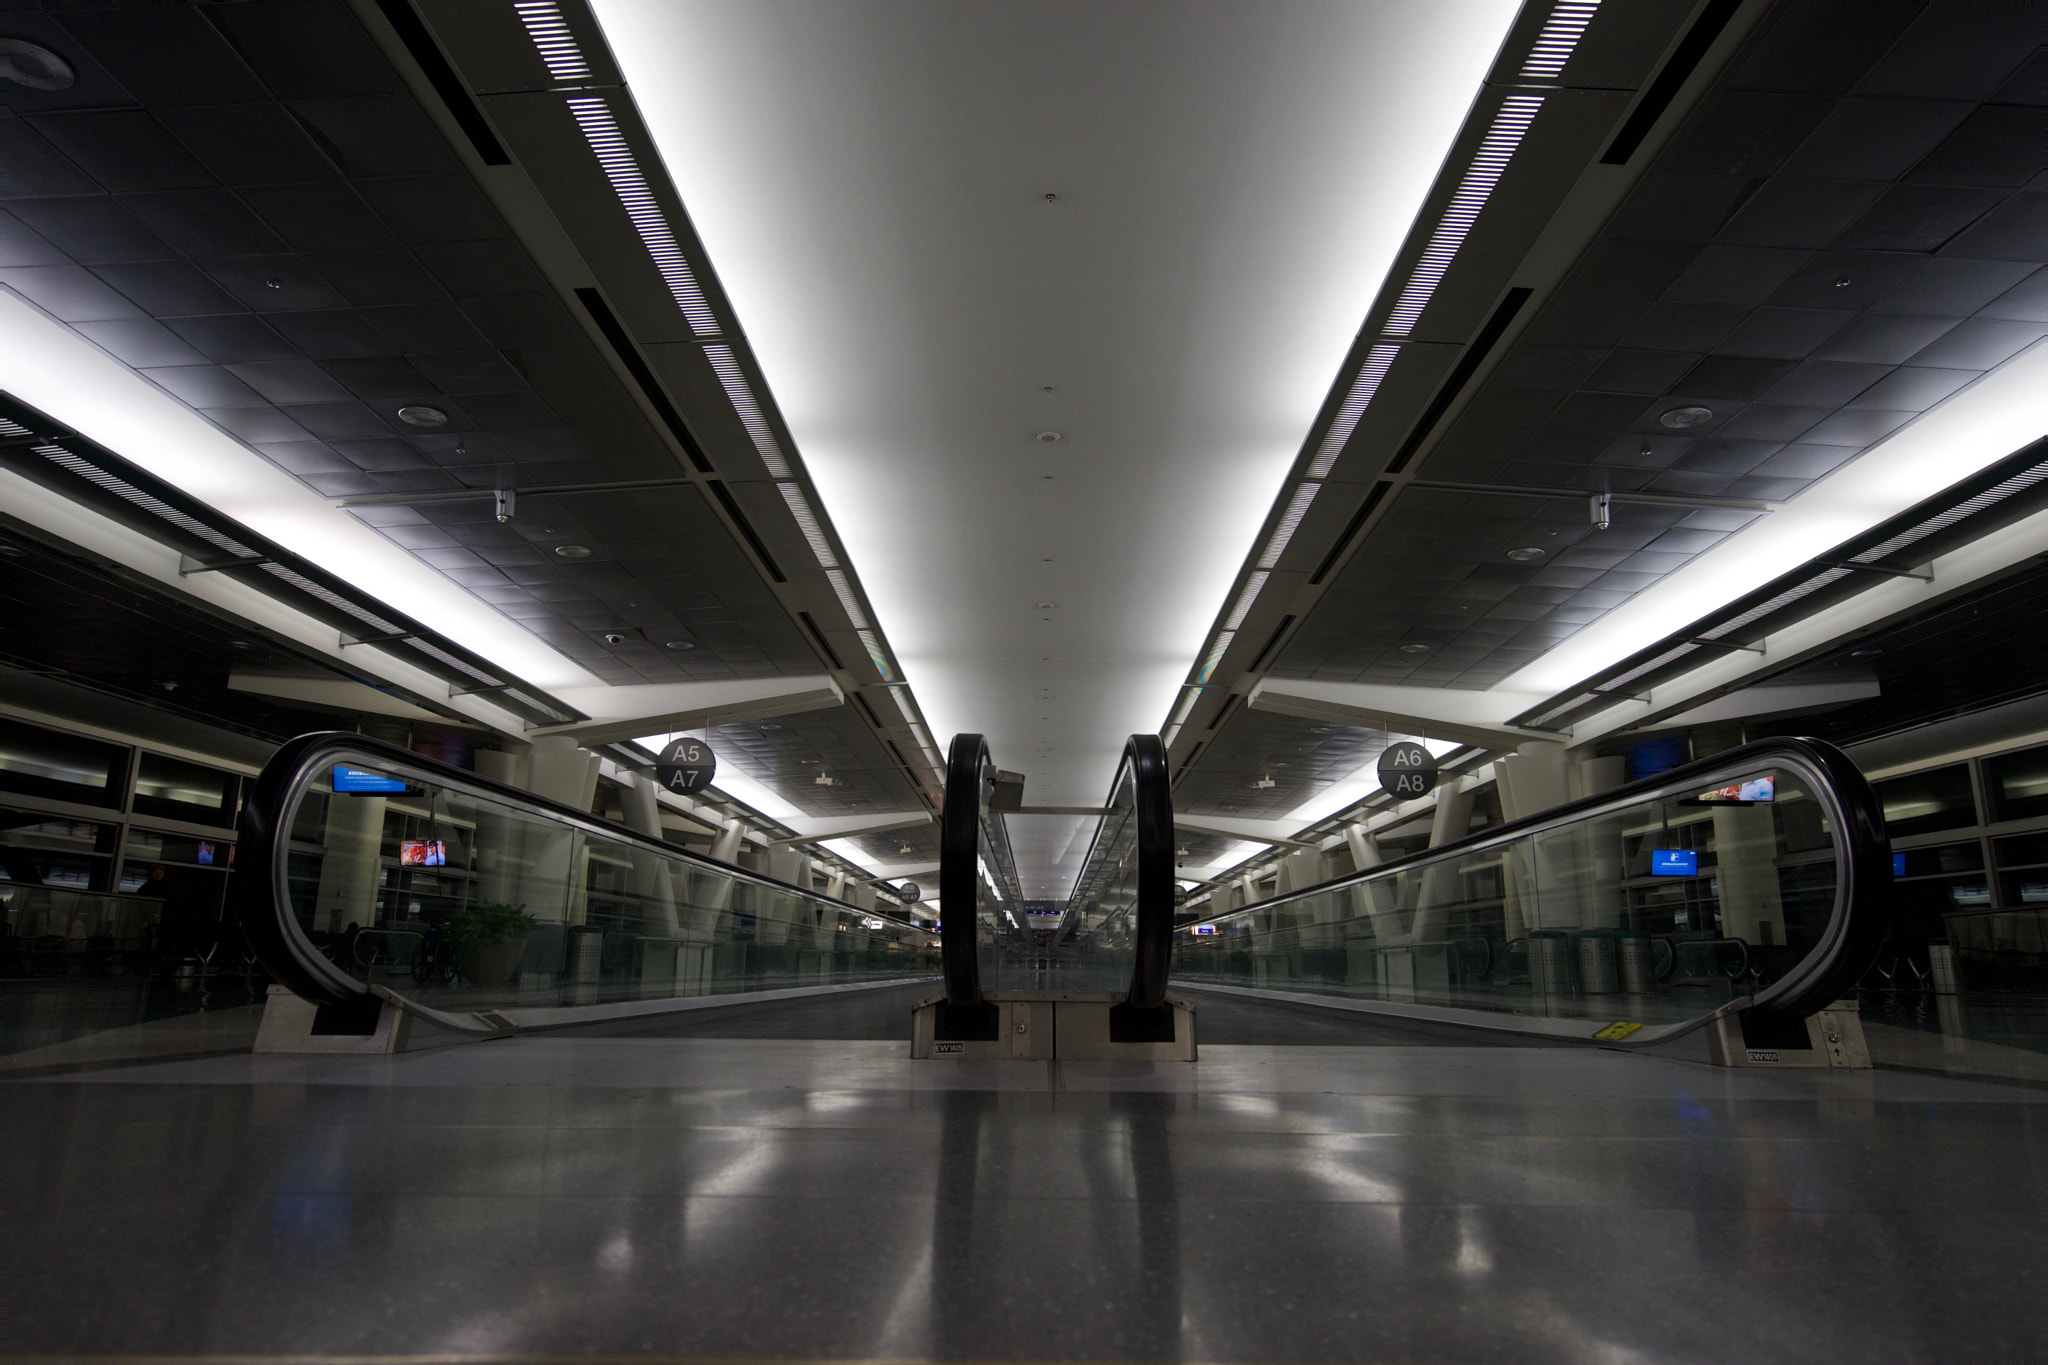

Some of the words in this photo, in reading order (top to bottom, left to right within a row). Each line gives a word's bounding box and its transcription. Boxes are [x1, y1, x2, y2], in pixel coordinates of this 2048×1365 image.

[672, 744, 700, 762] A5
[1393, 749, 1422, 767] A6
[669, 769, 699, 787] A7
[1396, 774, 1424, 792] A8
